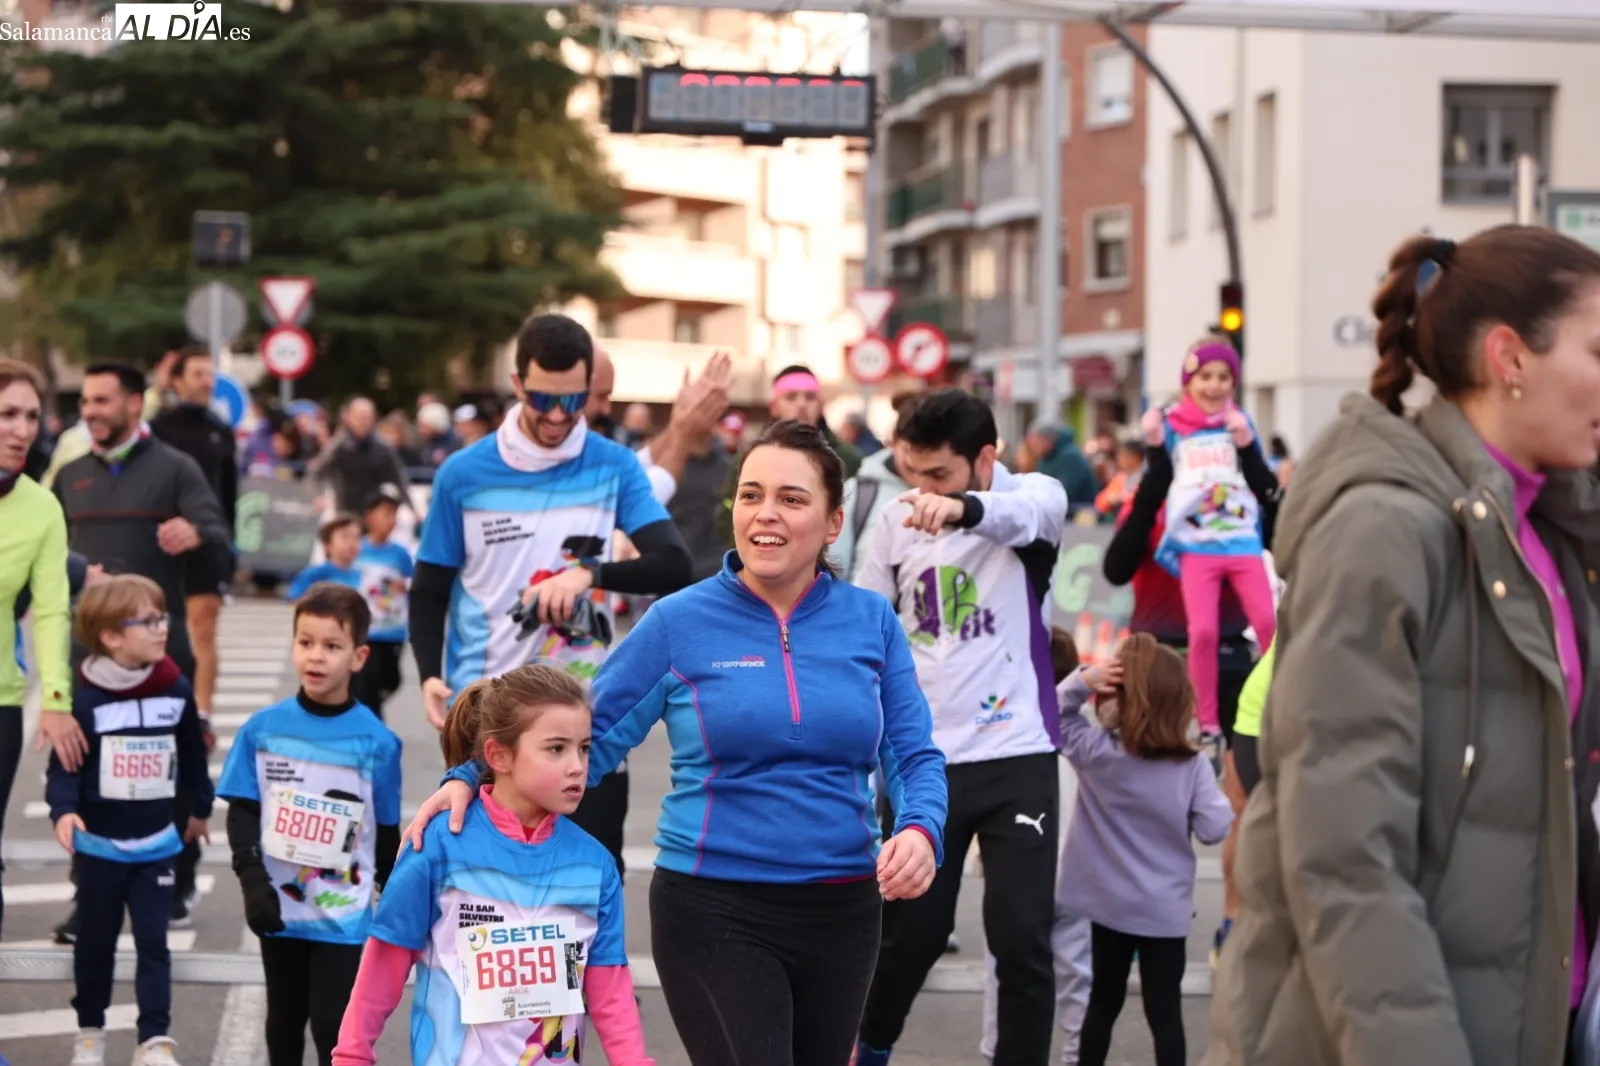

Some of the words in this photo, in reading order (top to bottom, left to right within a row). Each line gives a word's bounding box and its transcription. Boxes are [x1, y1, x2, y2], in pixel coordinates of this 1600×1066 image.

[112, 753, 163, 778] 6665
[293, 795, 353, 817] SETEL
[275, 806, 337, 845] 6806
[458, 912, 505, 923] SILVESTRE
[459, 903, 474, 912] XLI
[475, 904, 495, 913] SAN
[490, 924, 566, 945] SETEL
[475, 945, 557, 991] 6859
